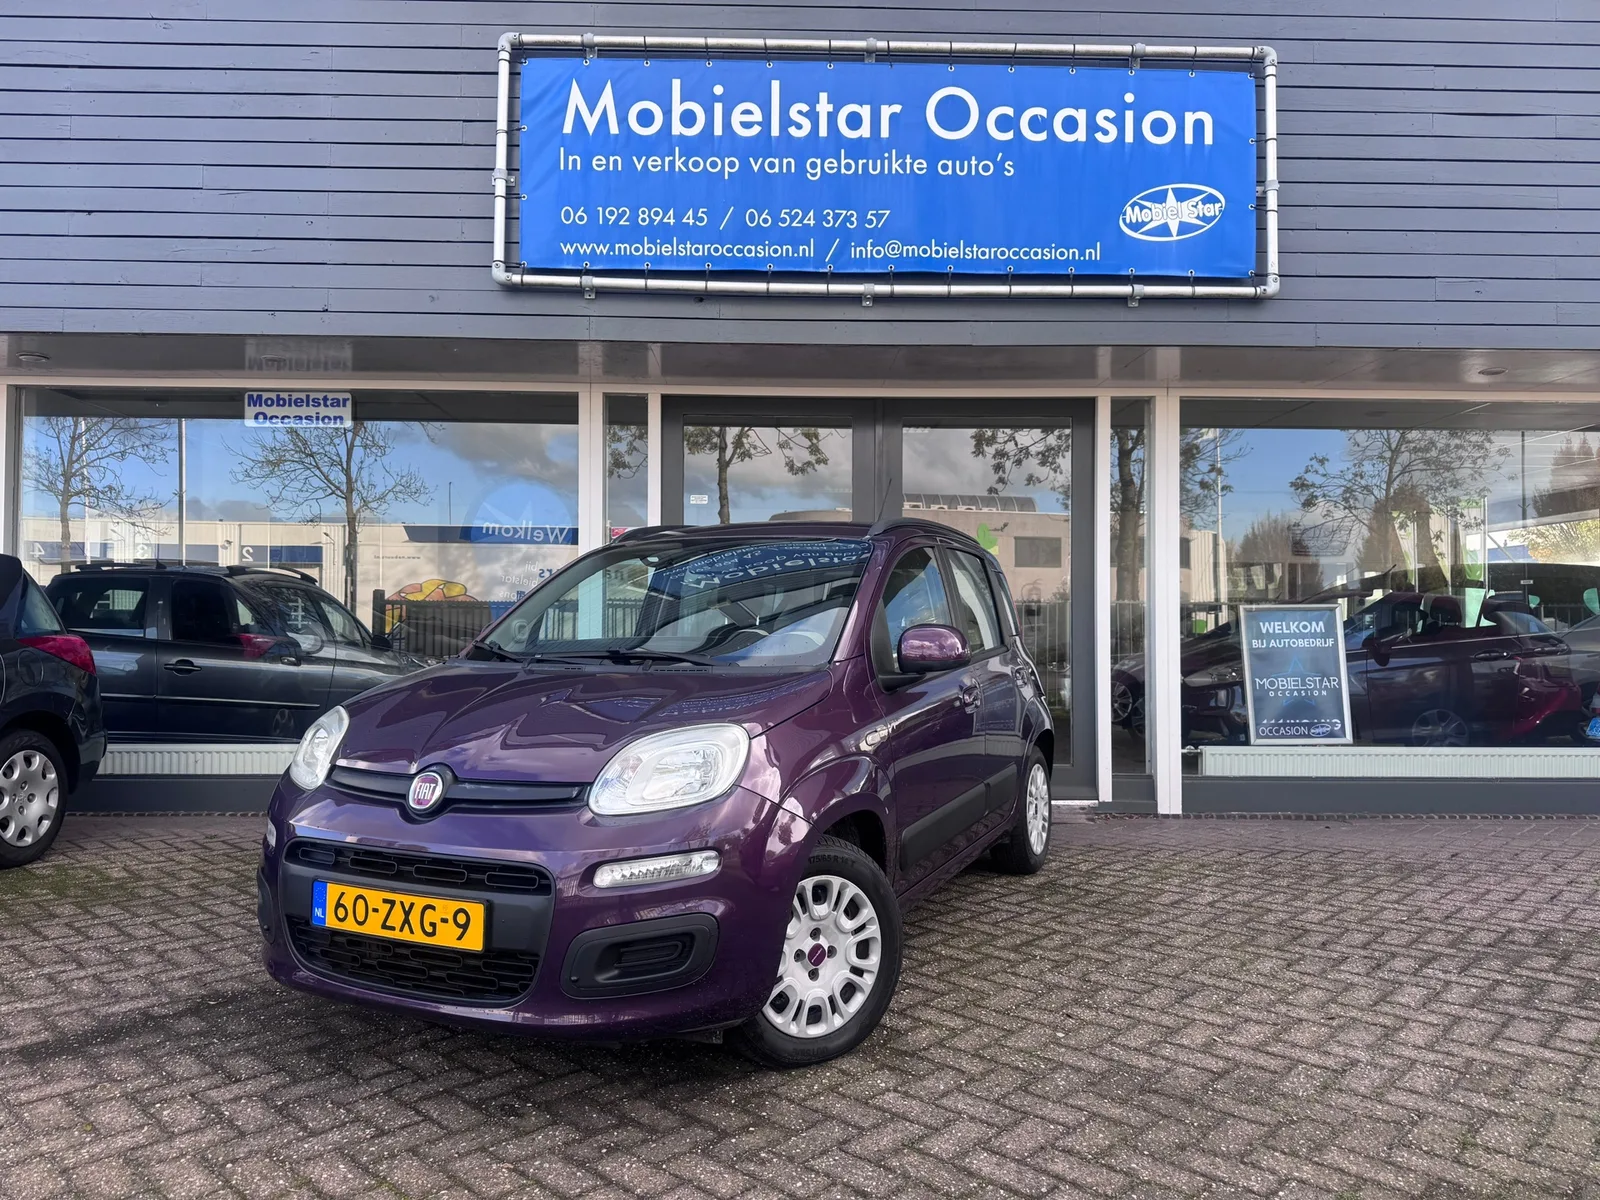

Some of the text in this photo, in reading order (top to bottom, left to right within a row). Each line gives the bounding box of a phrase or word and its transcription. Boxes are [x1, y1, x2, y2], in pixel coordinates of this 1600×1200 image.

[562, 78, 1213, 145] Mobielstar Occasion
[560, 147, 1015, 181] In en verkoop van gebruikte auto's
[560, 206, 891, 230] 06 192 894 45 / 06 524 373 57
[1125, 200, 1222, 224] Mobiel Star
[560, 237, 1100, 262] www.mobielstaroccasion.nl / info@mobielstaroccasion.nl
[247, 393, 350, 408] Mobielstar
[253, 411, 344, 426] Occasion
[1260, 621, 1325, 634] WELKOM
[1252, 638, 1335, 648] BIJ AUTOBEDRIJF
[1255, 677, 1339, 690] MOBIELSTAR
[1259, 726, 1308, 736] OCCASION
[415, 782, 436, 800] FIAT
[314, 891, 471, 941] NL 60-ZXG-9
